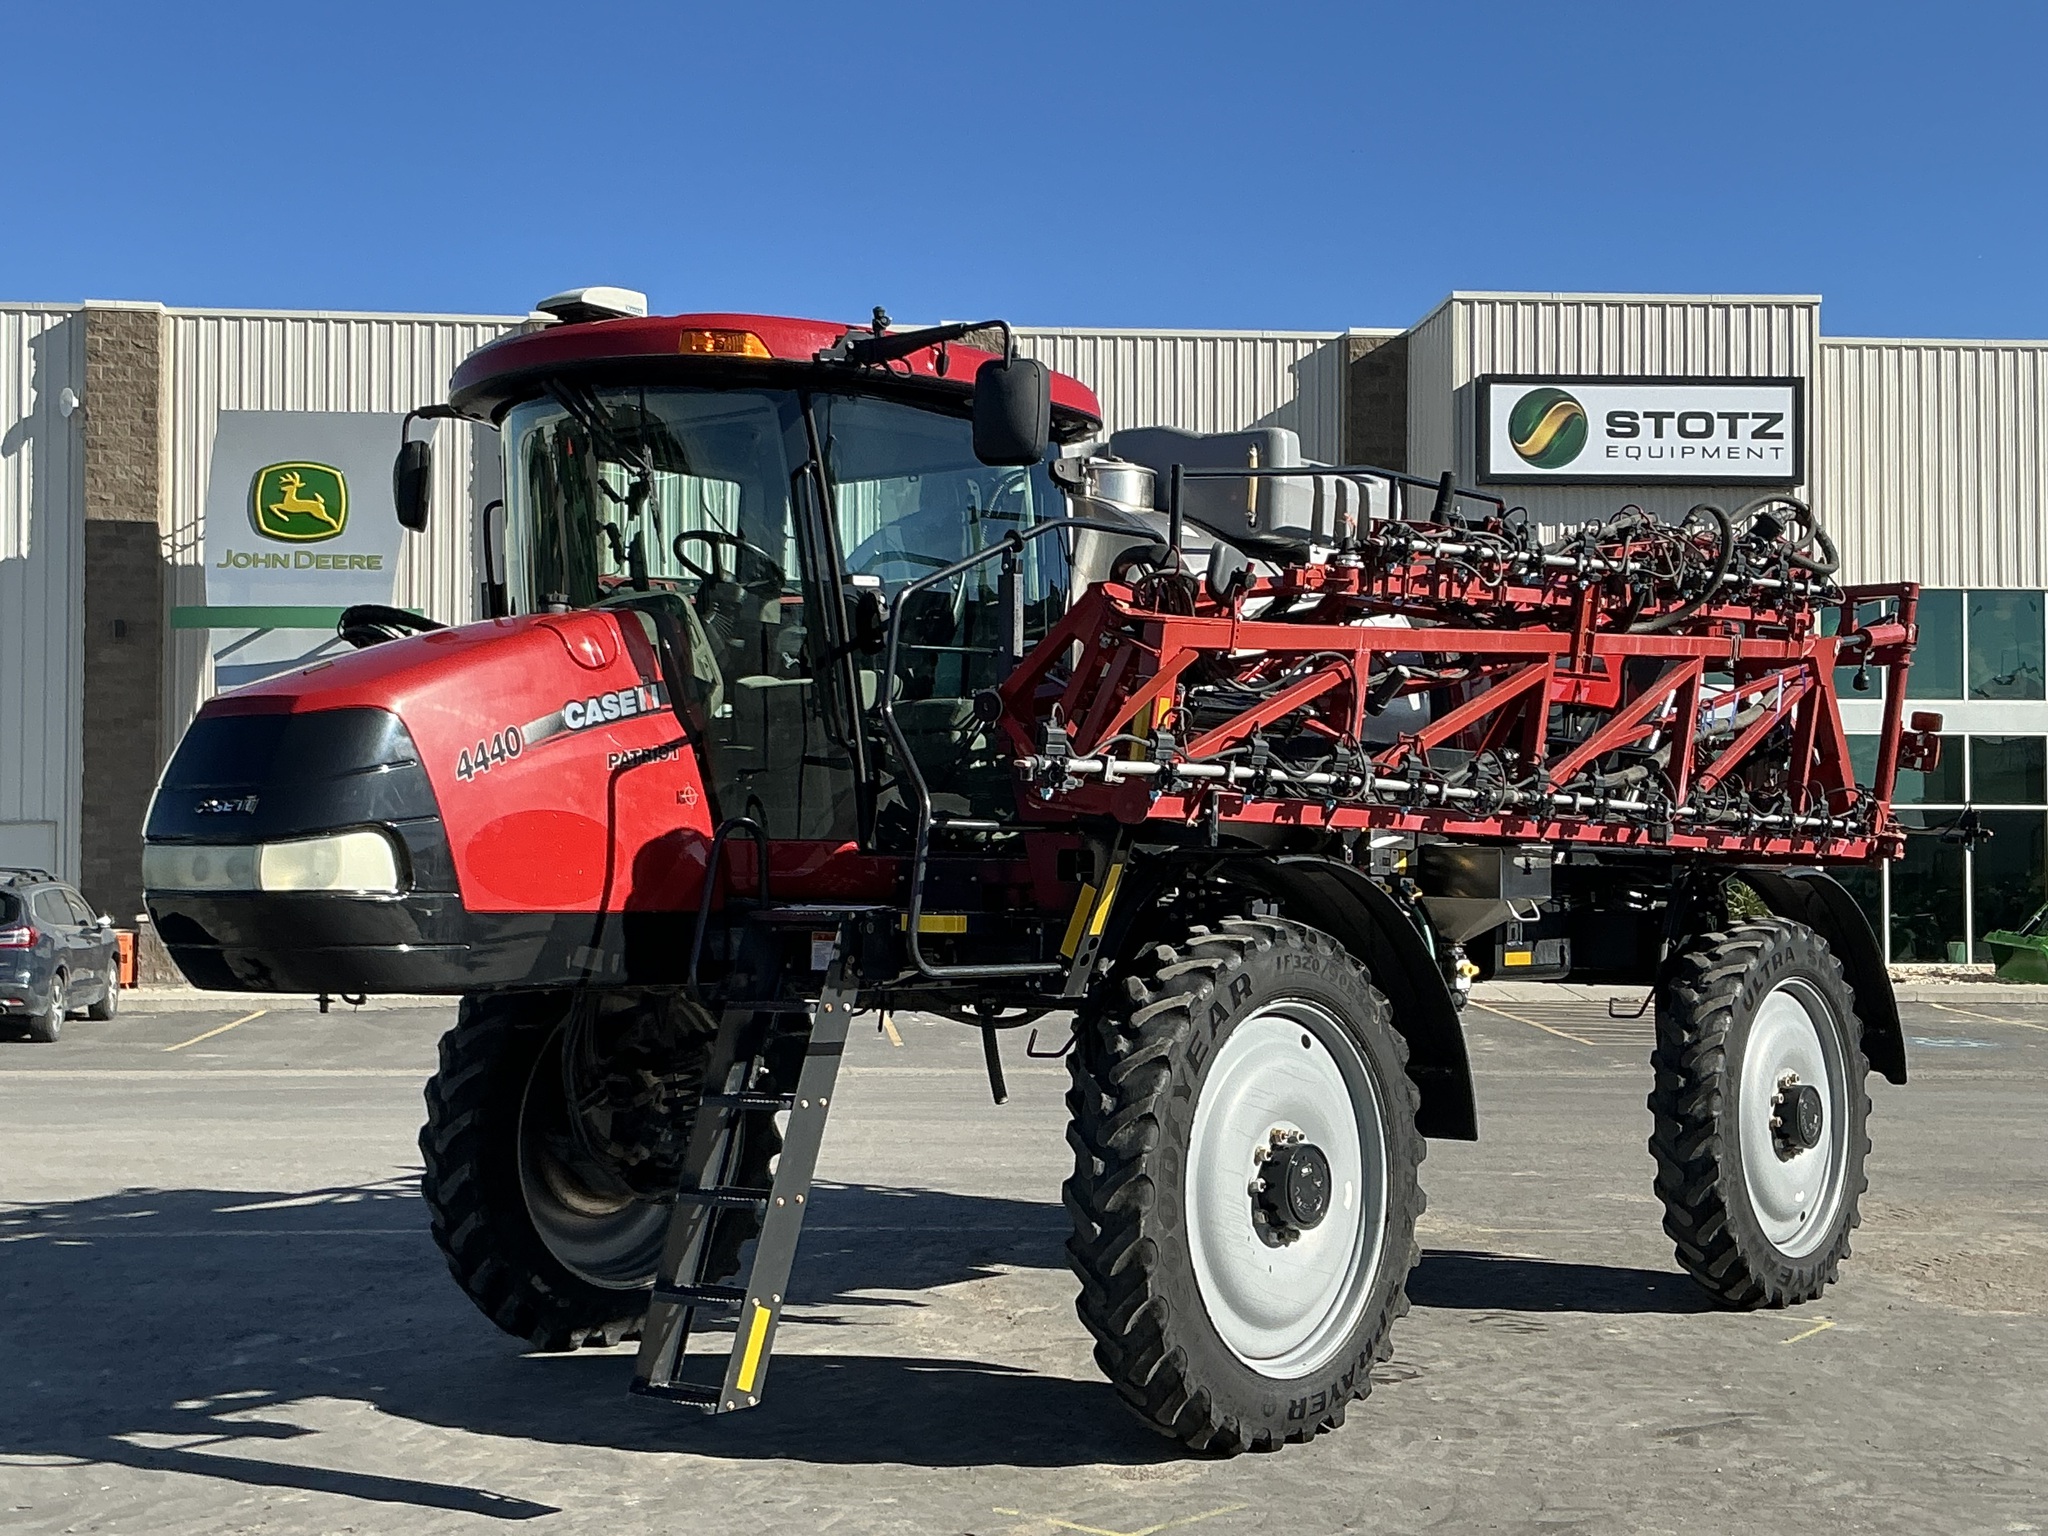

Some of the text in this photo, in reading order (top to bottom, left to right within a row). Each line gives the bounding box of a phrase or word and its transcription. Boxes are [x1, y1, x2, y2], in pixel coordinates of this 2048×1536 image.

[1605, 411, 1785, 440] STOTZ
[1605, 446, 1785, 460] EQUIPMENT
[216, 549, 383, 570] JOHN DEERE
[456, 725, 523, 781] 4440
[607, 744, 680, 771] PATRIOT
[1742, 946, 1796, 1012] ULTRA
